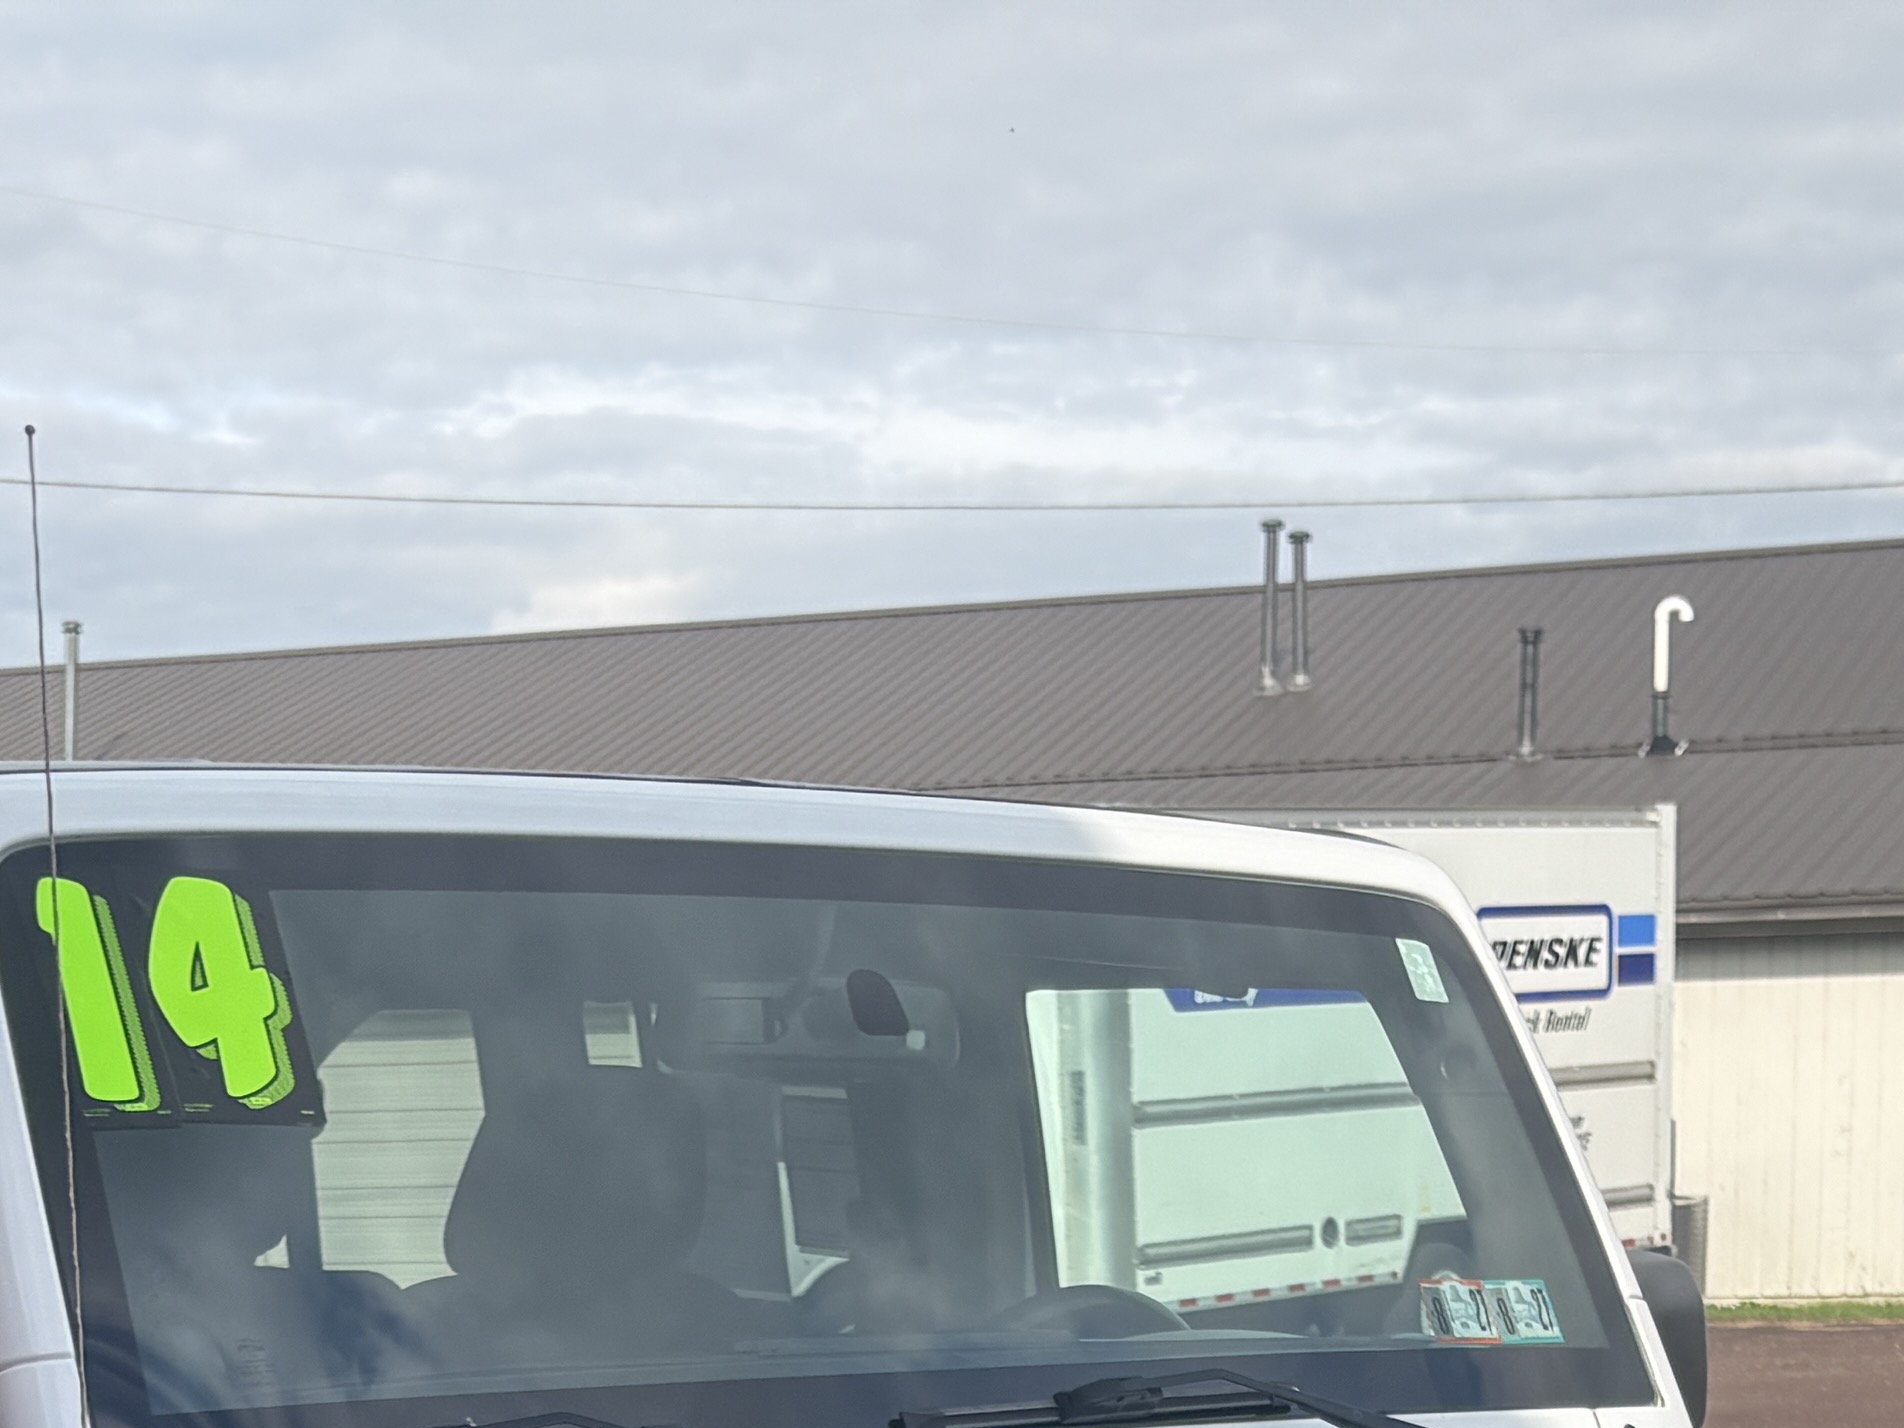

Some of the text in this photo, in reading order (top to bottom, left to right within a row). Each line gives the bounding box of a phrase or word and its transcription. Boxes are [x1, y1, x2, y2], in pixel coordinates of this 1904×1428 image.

[1492, 936, 1603, 971] PENSKE
[36, 876, 294, 1111] 14
[1545, 1006, 1593, 1034] Rental
[1433, 1296, 1450, 1335] 8
[1497, 1296, 1516, 1336] 8
